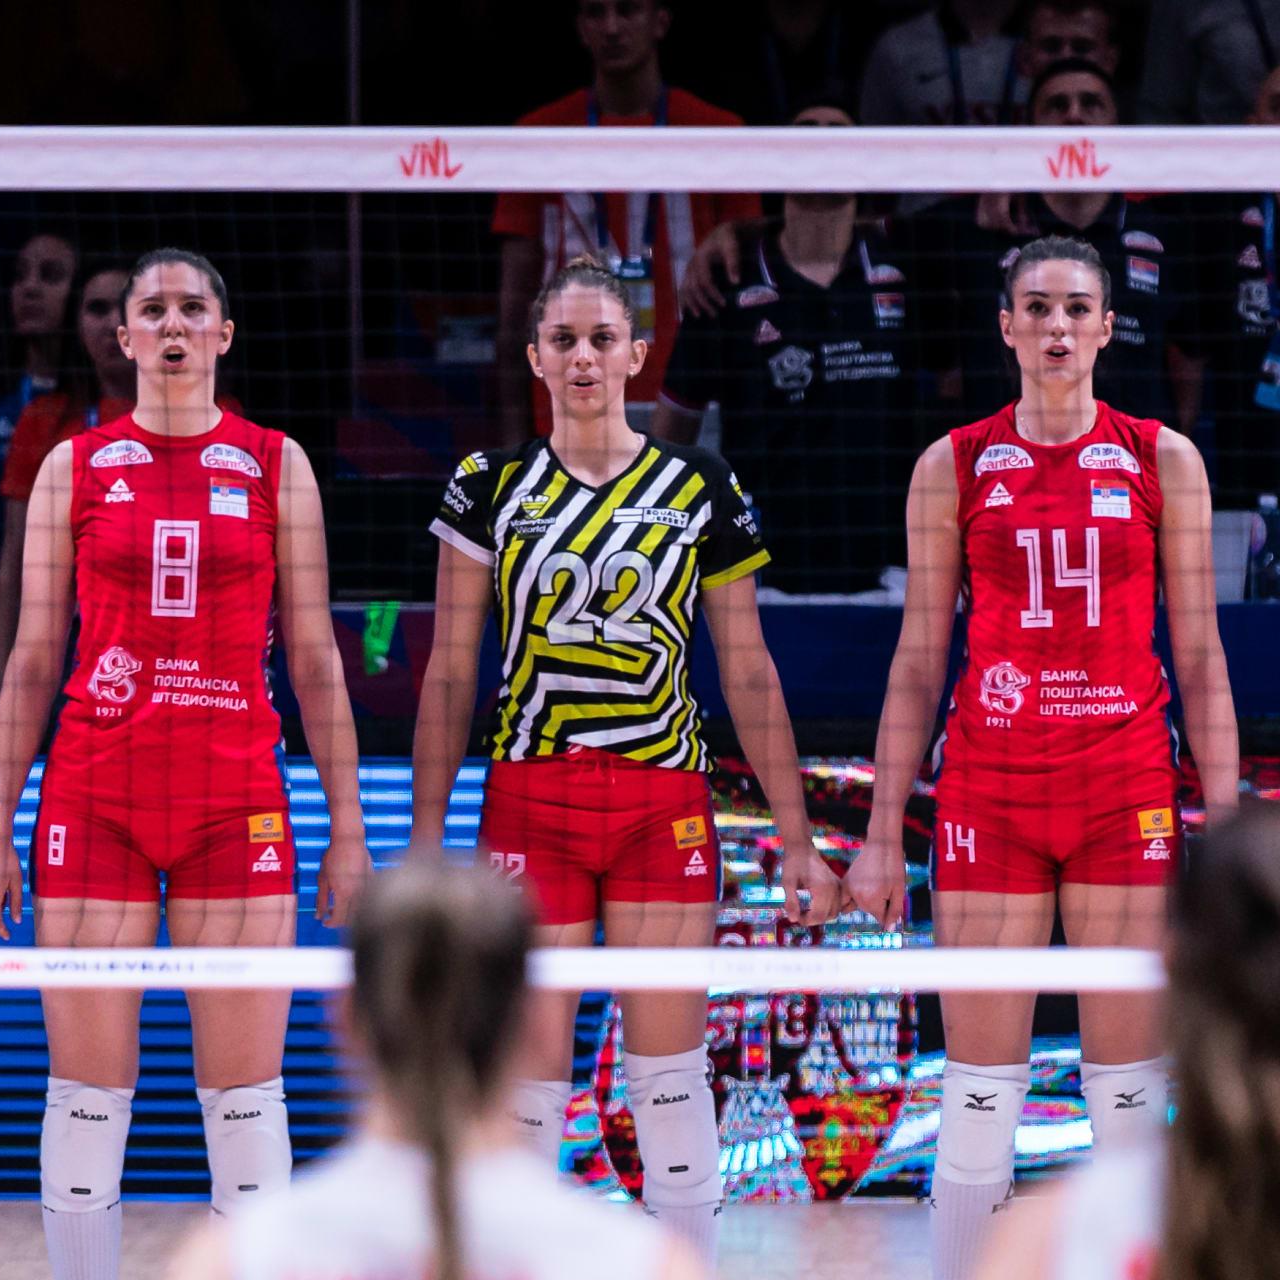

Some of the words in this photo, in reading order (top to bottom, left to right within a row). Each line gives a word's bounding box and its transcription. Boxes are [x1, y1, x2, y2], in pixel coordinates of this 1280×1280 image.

[400, 138, 461, 179] VNL
[1048, 139, 1108, 178] VNL
[105, 492, 135, 503] PEAK
[985, 495, 1014, 507] PEAK
[151, 520, 199, 618] 8
[1016, 527, 1100, 628] 14
[538, 550, 654, 644] 22
[155, 658, 199, 671] БАНКА
[1041, 670, 1088, 682] БАНКА
[154, 675, 239, 692] ПОШТАНСКА
[1040, 686, 1124, 698] ПОШТАНСКА
[151, 692, 248, 711] ШТЕДИОНИЦА
[1040, 701, 1138, 716] ШТЕДИОНИЦА
[95, 707, 122, 717] 1921
[986, 717, 1011, 728] 1921
[48, 825, 66, 865] 8
[944, 822, 975, 863] 14
[1143, 849, 1170, 860] PEAK
[252, 861, 281, 872] PEAK
[684, 865, 707, 877] PEAK
